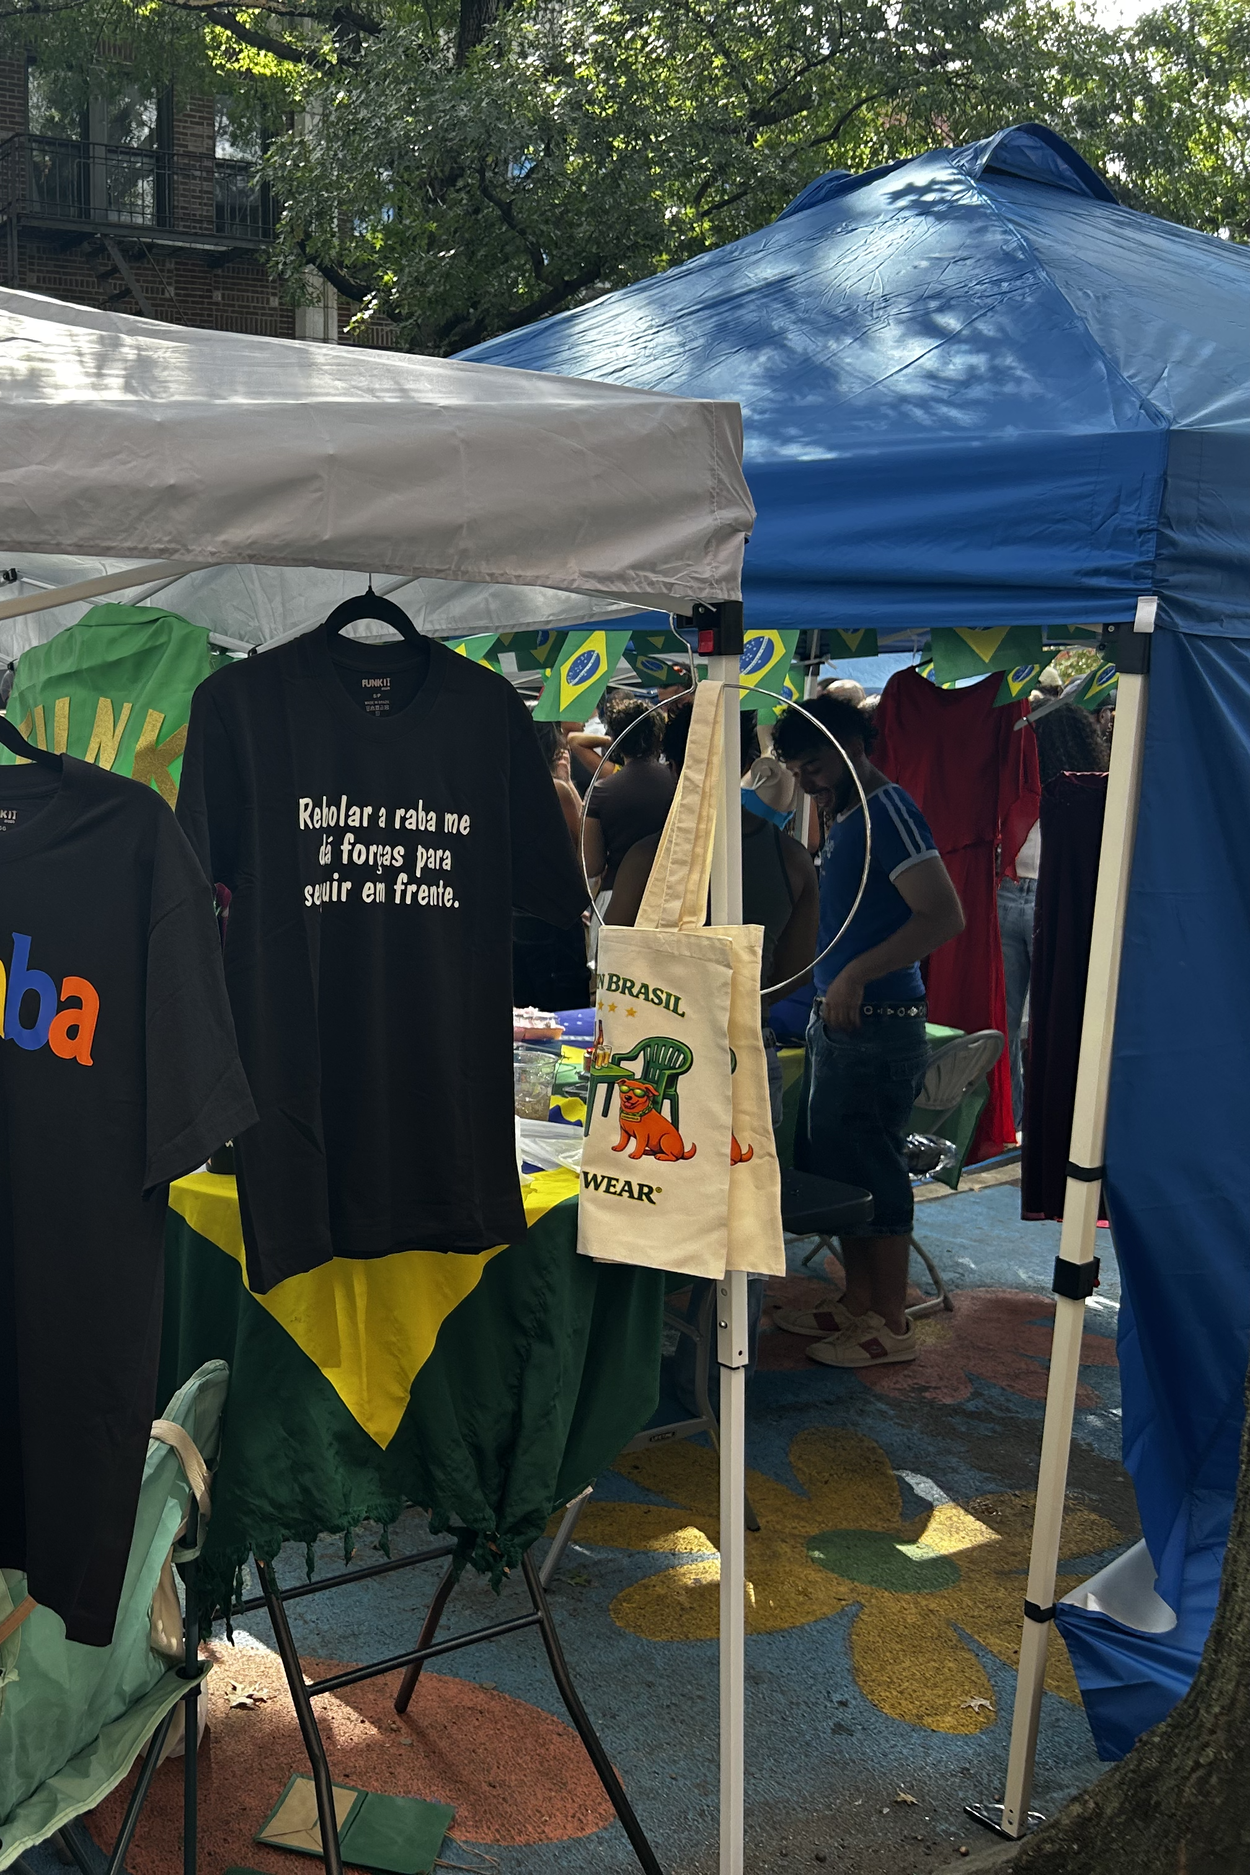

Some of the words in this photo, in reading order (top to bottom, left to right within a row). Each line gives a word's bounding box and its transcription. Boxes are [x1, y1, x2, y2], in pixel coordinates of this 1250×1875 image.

[299, 795, 373, 830] Rebolar
[378, 806, 386, 829] a
[395, 799, 436, 832] raba
[444, 811, 470, 835] me
[319, 833, 333, 866] dá
[340, 832, 405, 875] forças
[416, 844, 451, 878] para
[304, 872, 352, 913] seuir
[362, 880, 385, 904] em
[394, 872, 460, 908] frente.
[605, 972, 686, 1018] BRASIL
